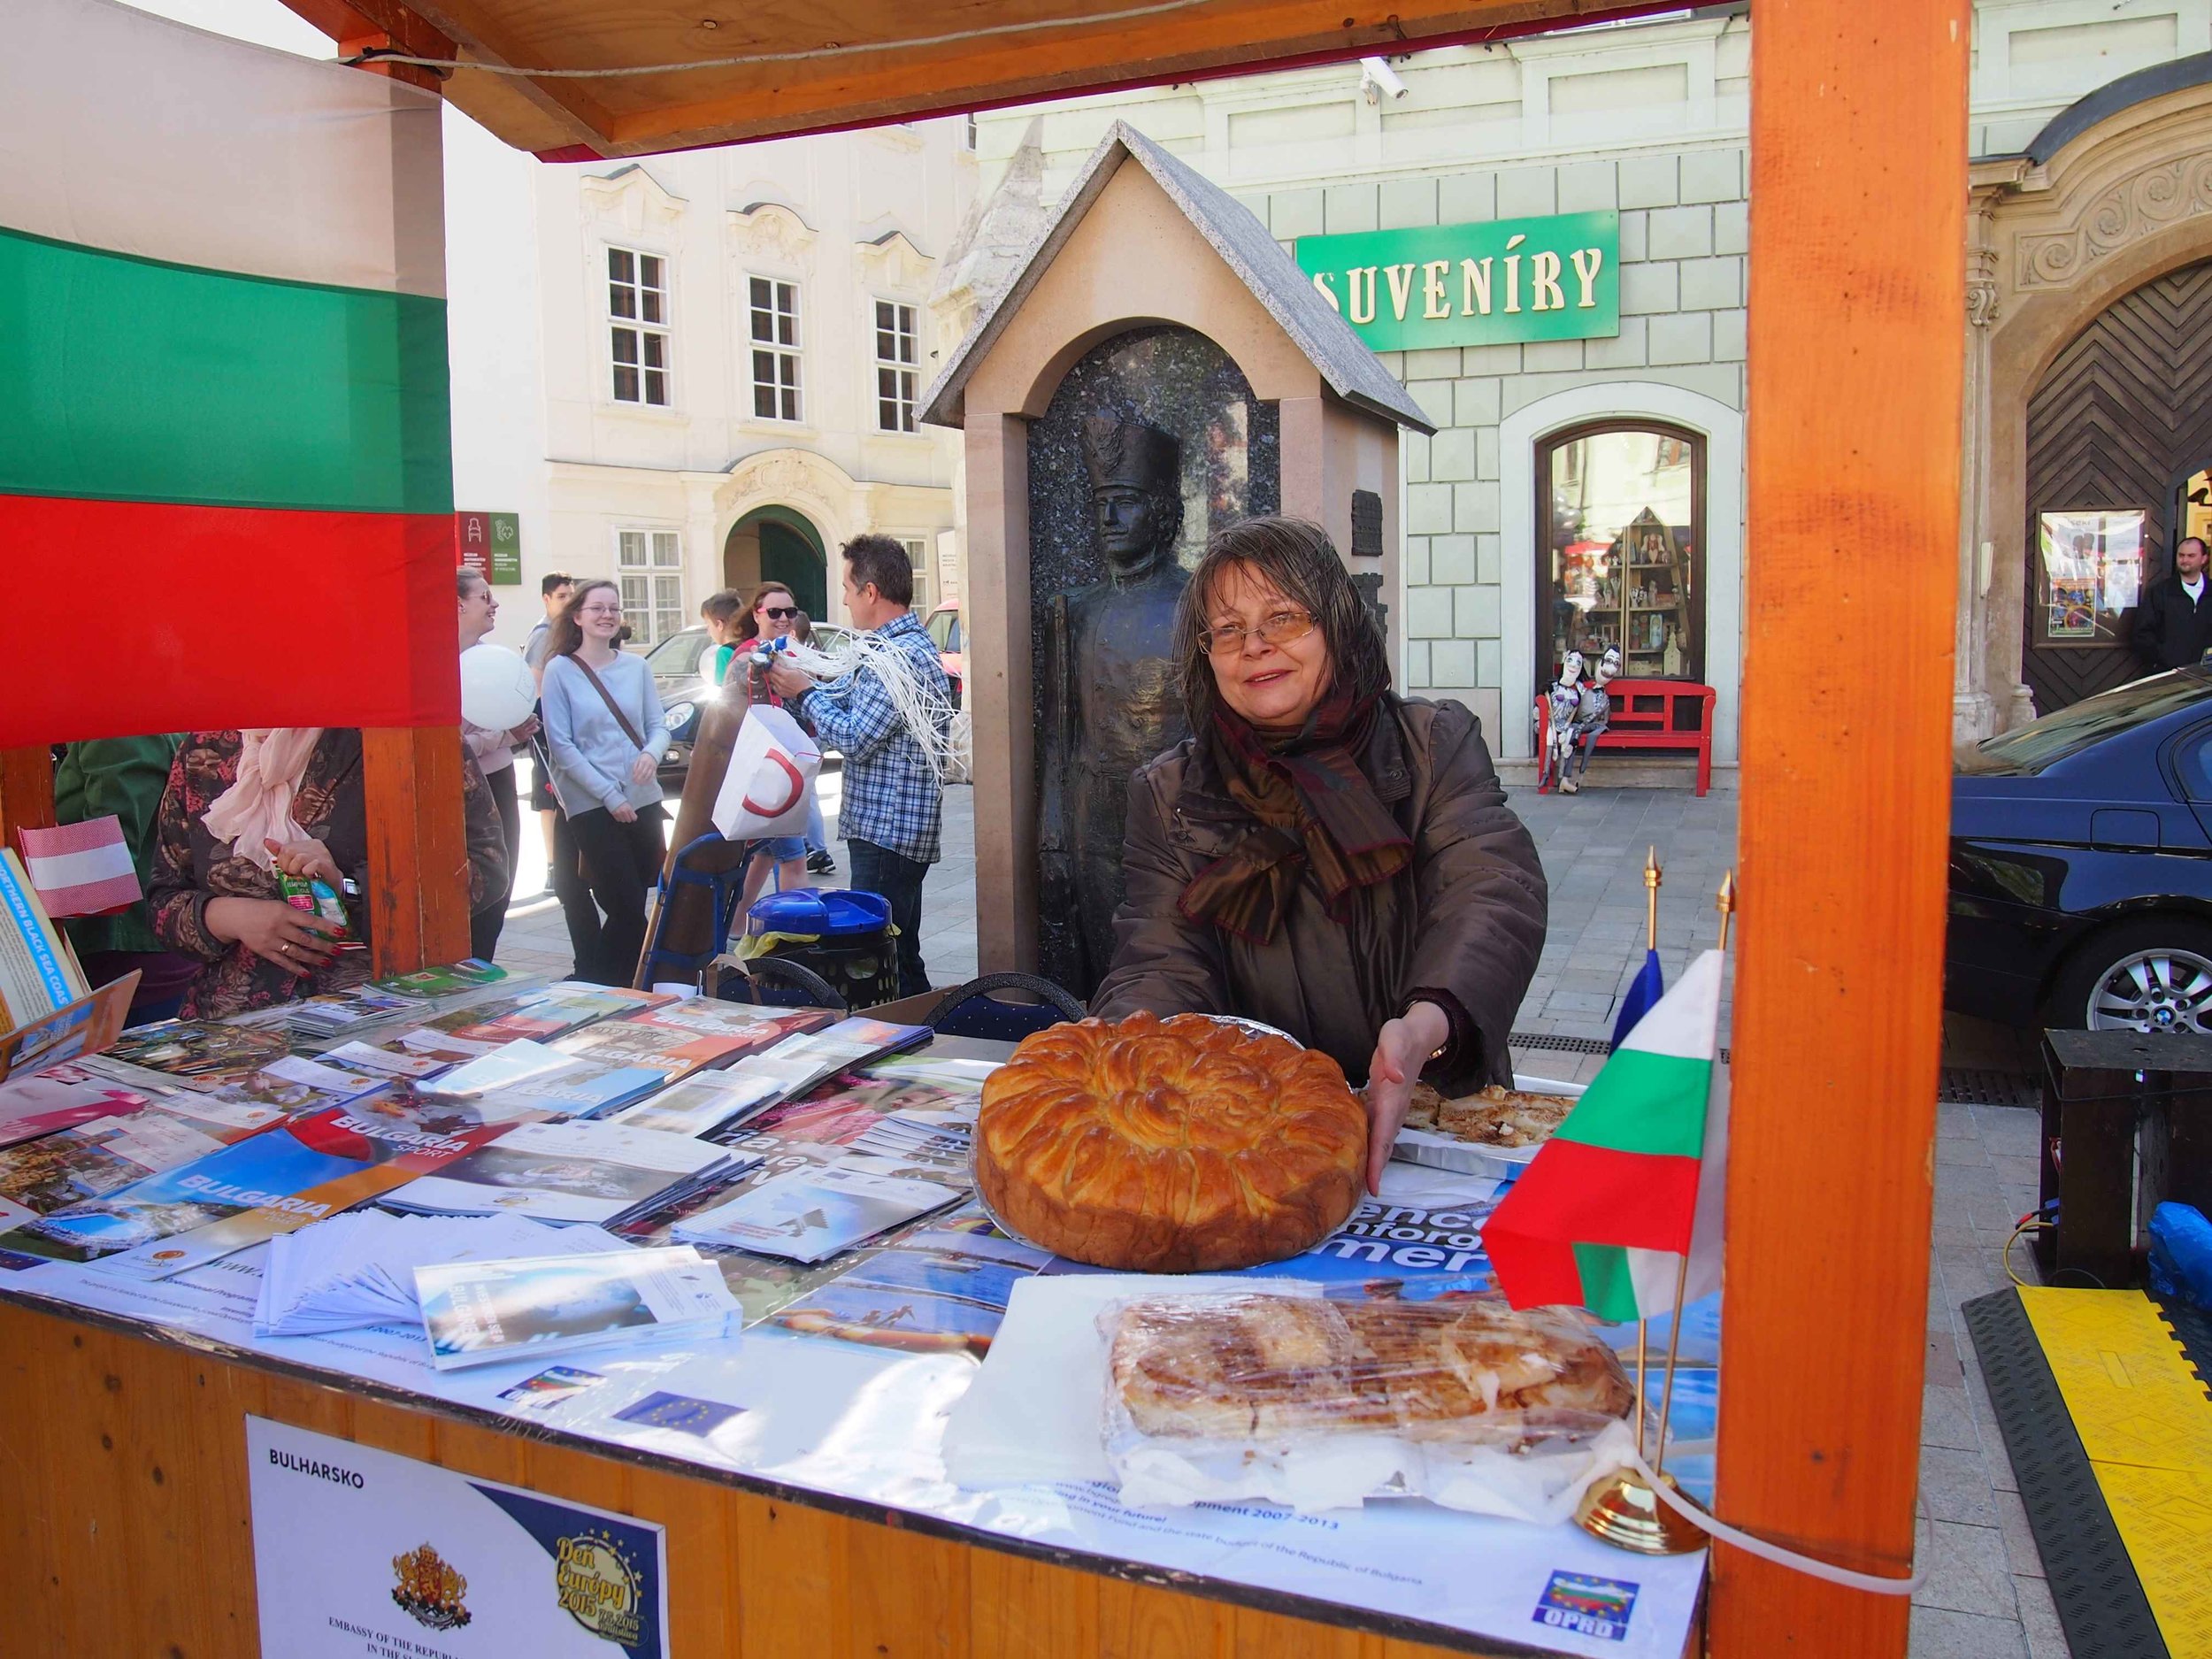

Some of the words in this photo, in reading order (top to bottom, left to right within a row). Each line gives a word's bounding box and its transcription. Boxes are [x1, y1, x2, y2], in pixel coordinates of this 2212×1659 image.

[1313, 234, 1602, 324] SUVENÍRY
[23, 918, 45, 956] BLACK
[38, 948, 55, 974] SEA
[330, 1116, 469, 1152] BULGARIA
[393, 1144, 453, 1159] SPORT
[177, 1174, 332, 1217] BULGARIA
[269, 1448, 365, 1489] BULHARSKO
[1253, 1508, 1340, 1531] 2007-2013
[557, 1537, 595, 1569] Deň
[1298, 1550, 1352, 1571] Republic
[557, 1563, 626, 1610] Európy
[558, 1588, 597, 1617] 2015
[328, 1617, 373, 1639] EMBASSY
[376, 1632, 389, 1644] OF
[392, 1636, 413, 1652] THE
[1544, 1609, 1614, 1638] OPRD
[367, 1643, 378, 1655] IN
[380, 1647, 401, 1659] THE
